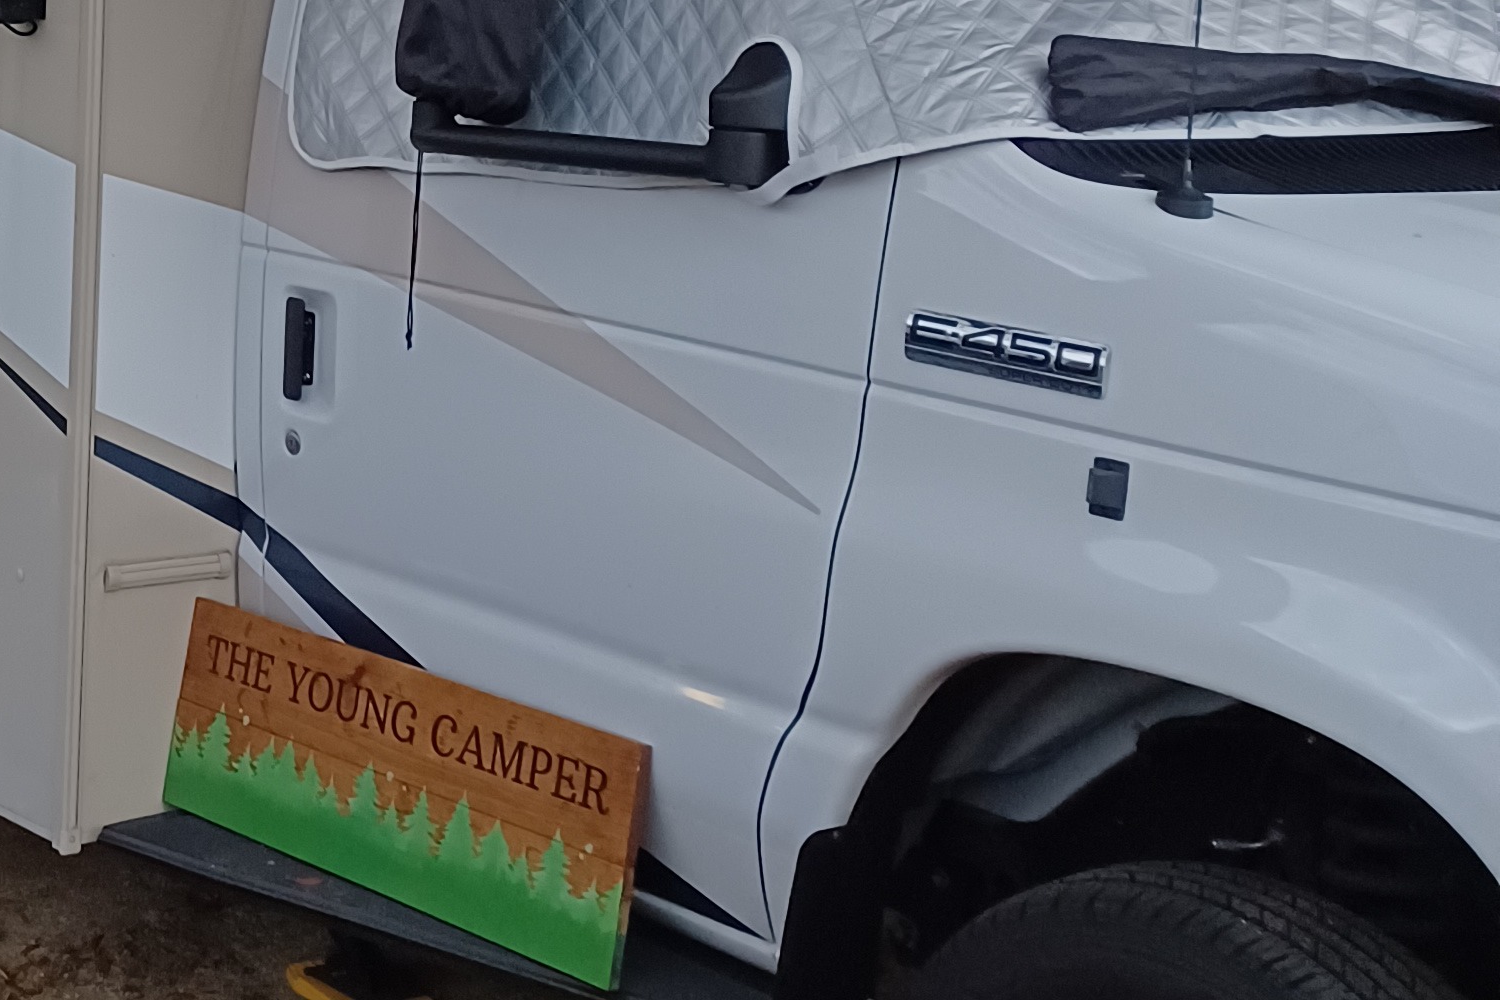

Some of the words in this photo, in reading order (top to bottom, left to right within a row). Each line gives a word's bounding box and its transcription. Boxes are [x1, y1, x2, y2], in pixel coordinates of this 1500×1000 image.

[909, 313, 1104, 378] E-450
[207, 635, 276, 694] THE
[287, 660, 418, 745] YOUNG
[430, 714, 610, 816] CAMPER
